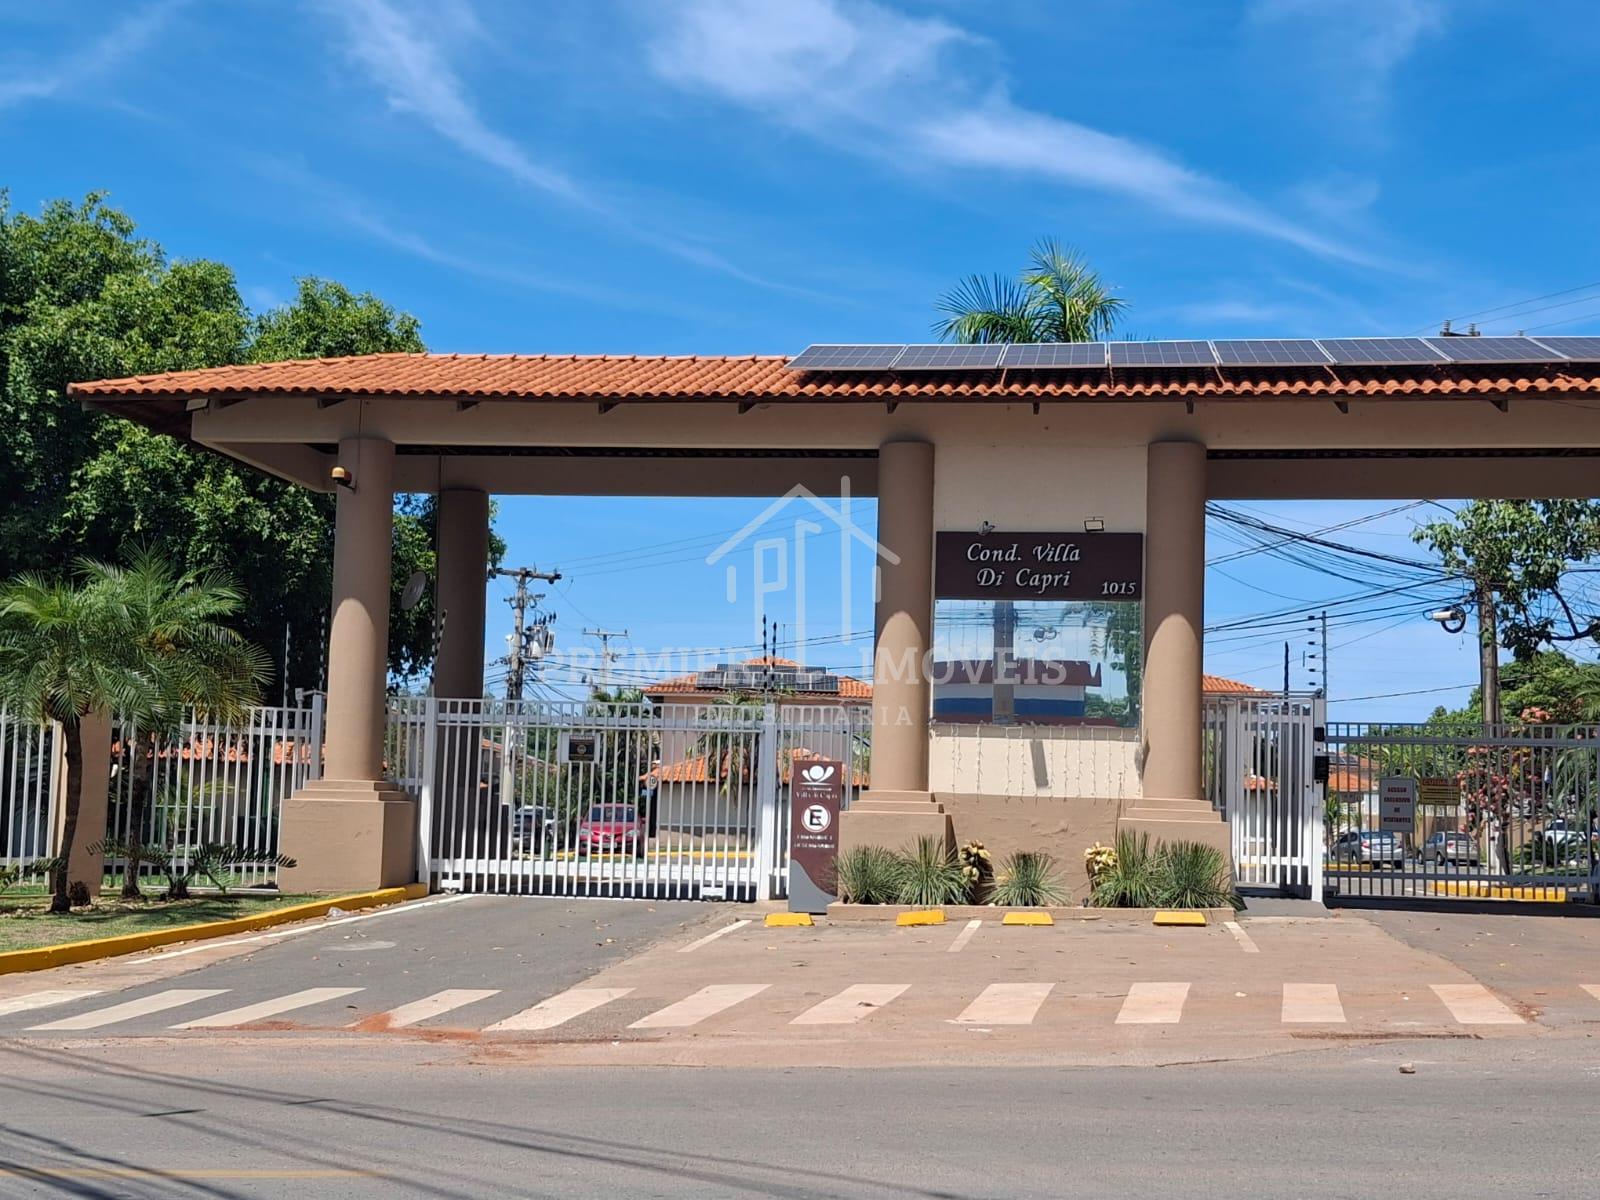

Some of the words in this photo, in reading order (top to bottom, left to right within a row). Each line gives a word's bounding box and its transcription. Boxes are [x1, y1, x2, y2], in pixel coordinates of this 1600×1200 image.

[967, 543, 1022, 562] Cond.
[1033, 543, 1081, 562] Villa
[976, 567, 1005, 587] Di
[1015, 568, 1071, 594] Capri
[1101, 582, 1137, 595] 1015
